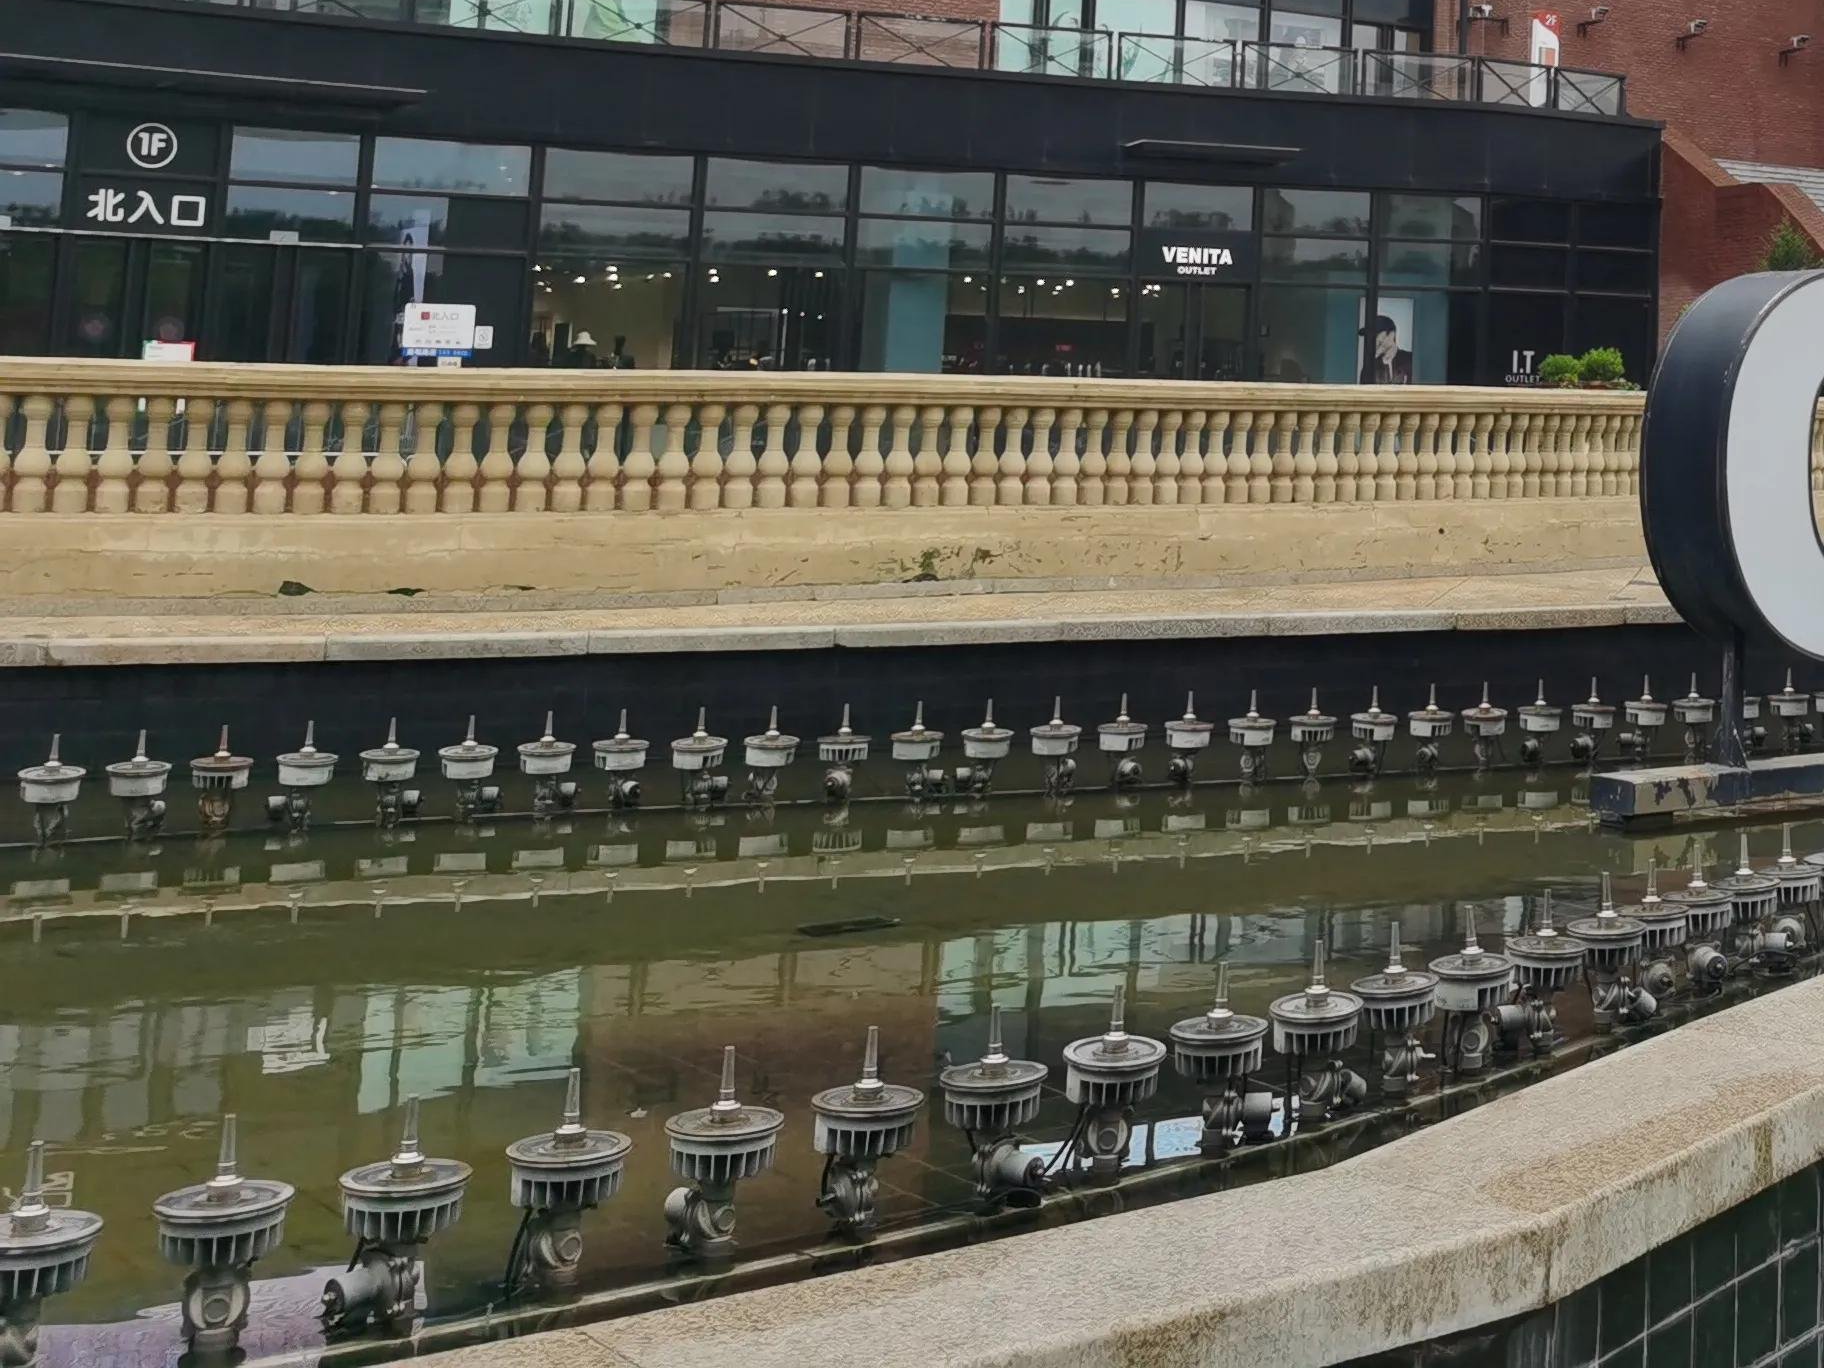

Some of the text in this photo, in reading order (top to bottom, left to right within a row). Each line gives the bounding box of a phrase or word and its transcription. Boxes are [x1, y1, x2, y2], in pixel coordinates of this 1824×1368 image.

[138, 131, 167, 158] 1F
[87, 188, 207, 228] 北入口
[1161, 246, 1233, 265] VENITA
[1177, 265, 1217, 275] OUTLET
[1505, 374, 1541, 384] OUTLET
